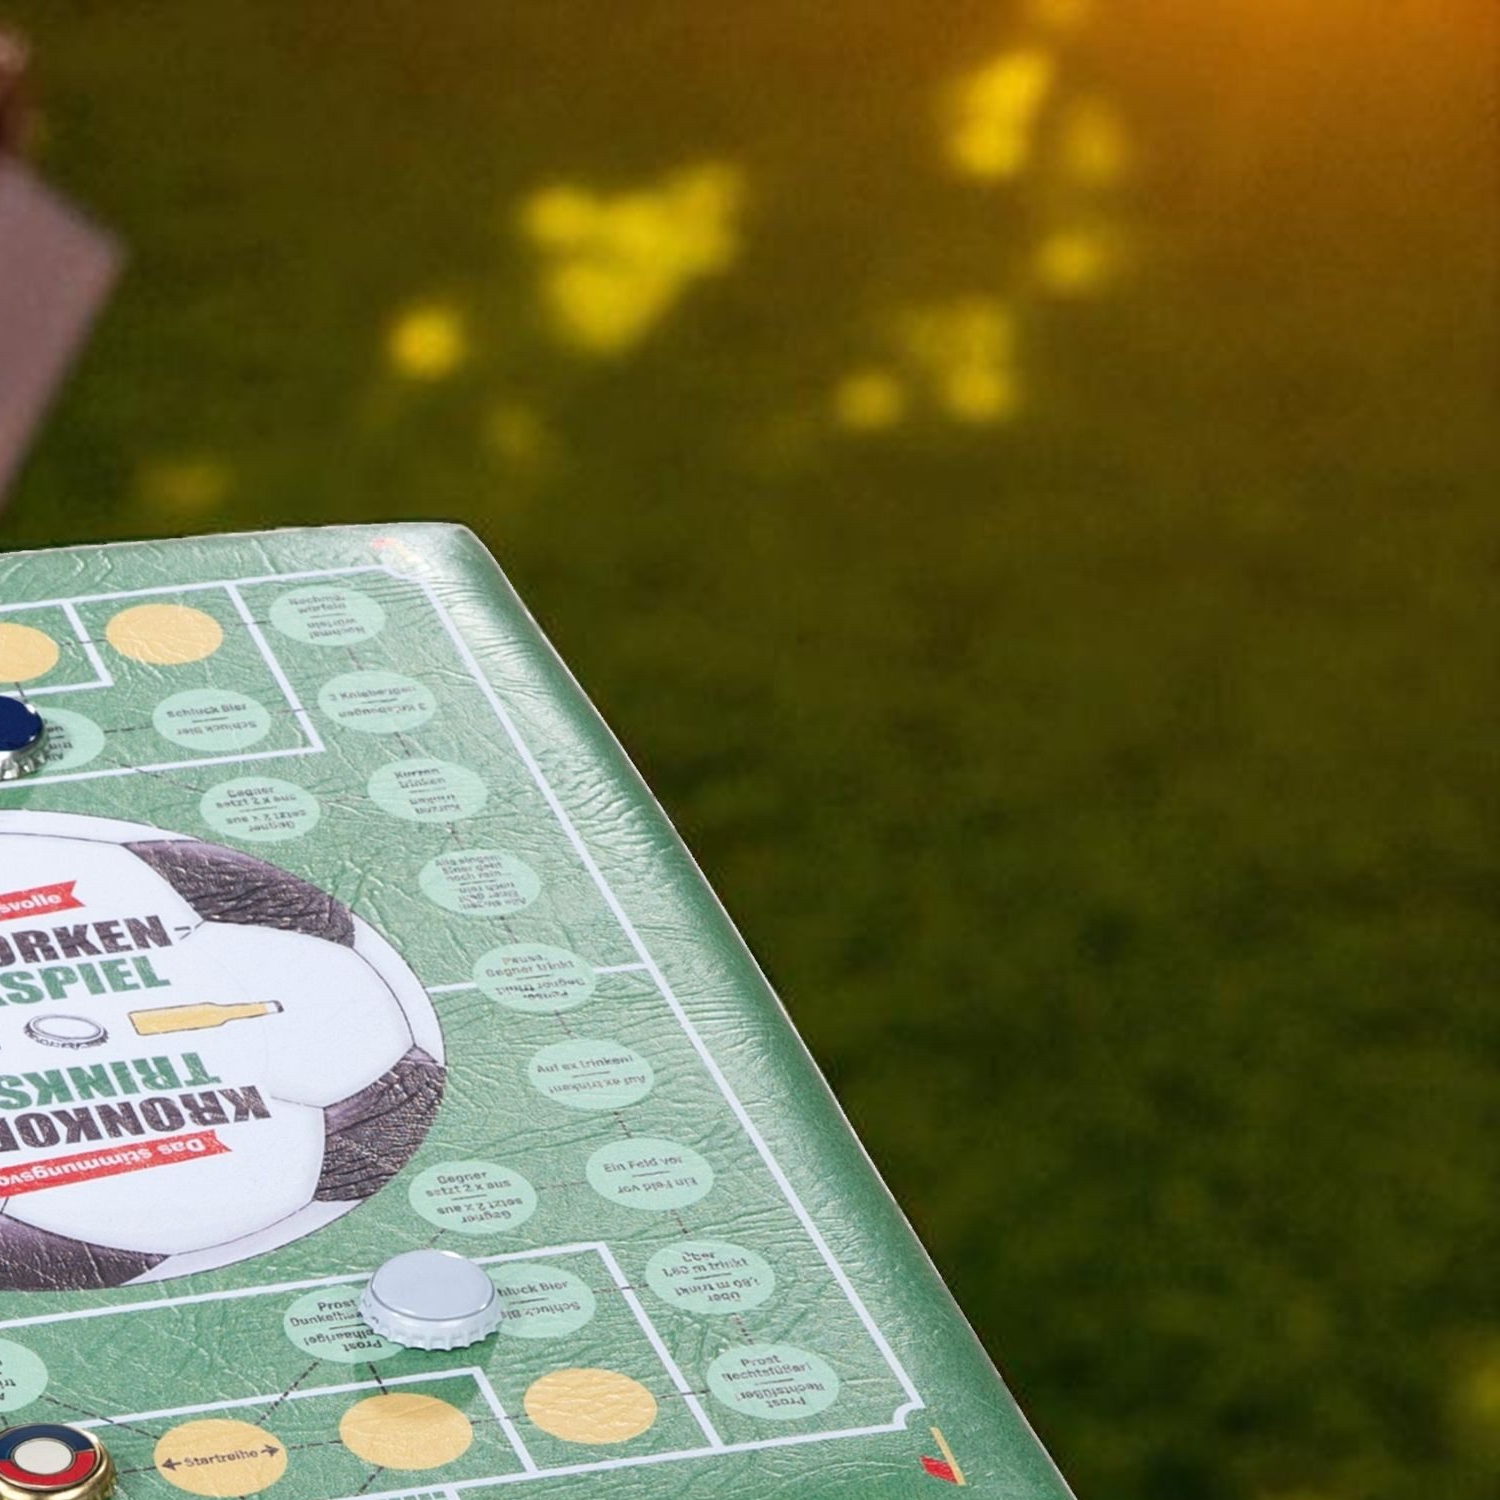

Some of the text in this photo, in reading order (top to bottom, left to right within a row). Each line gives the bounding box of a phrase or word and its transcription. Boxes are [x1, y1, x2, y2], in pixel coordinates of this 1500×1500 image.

[158, 1138, 208, 1156] Das
[603, 1162, 627, 1173] Ein
[436, 1171, 488, 1185] Gegner
[539, 1280, 568, 1292] Bier
[317, 1299, 357, 1311] Prost
[341, 1339, 383, 1352] Prost
[740, 1354, 782, 1368] Prost
[184, 1449, 259, 1467] Startreihe
